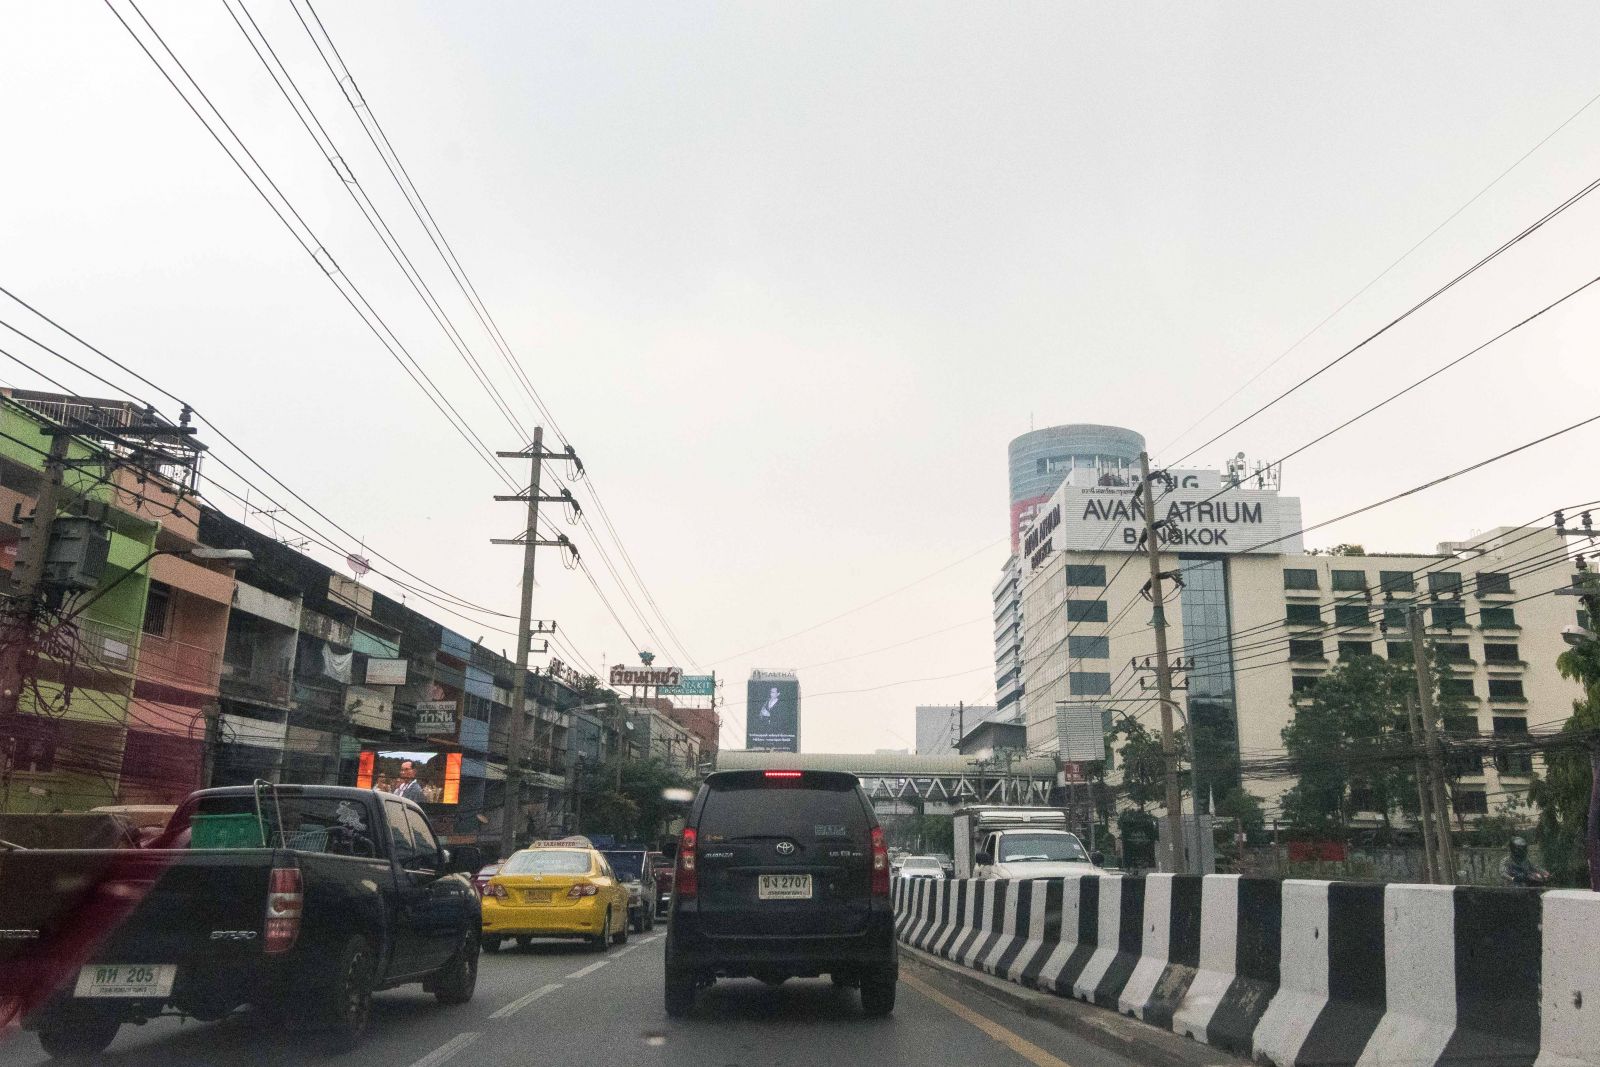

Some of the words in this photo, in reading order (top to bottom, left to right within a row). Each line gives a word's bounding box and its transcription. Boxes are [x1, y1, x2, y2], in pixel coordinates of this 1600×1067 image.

[1082, 498, 1149, 522] AVAN
[1168, 499, 1262, 524] ATRIUM
[1123, 526, 1228, 546] BNGKOK
[781, 876, 807, 888] 2707
[126, 967, 154, 984] 205
